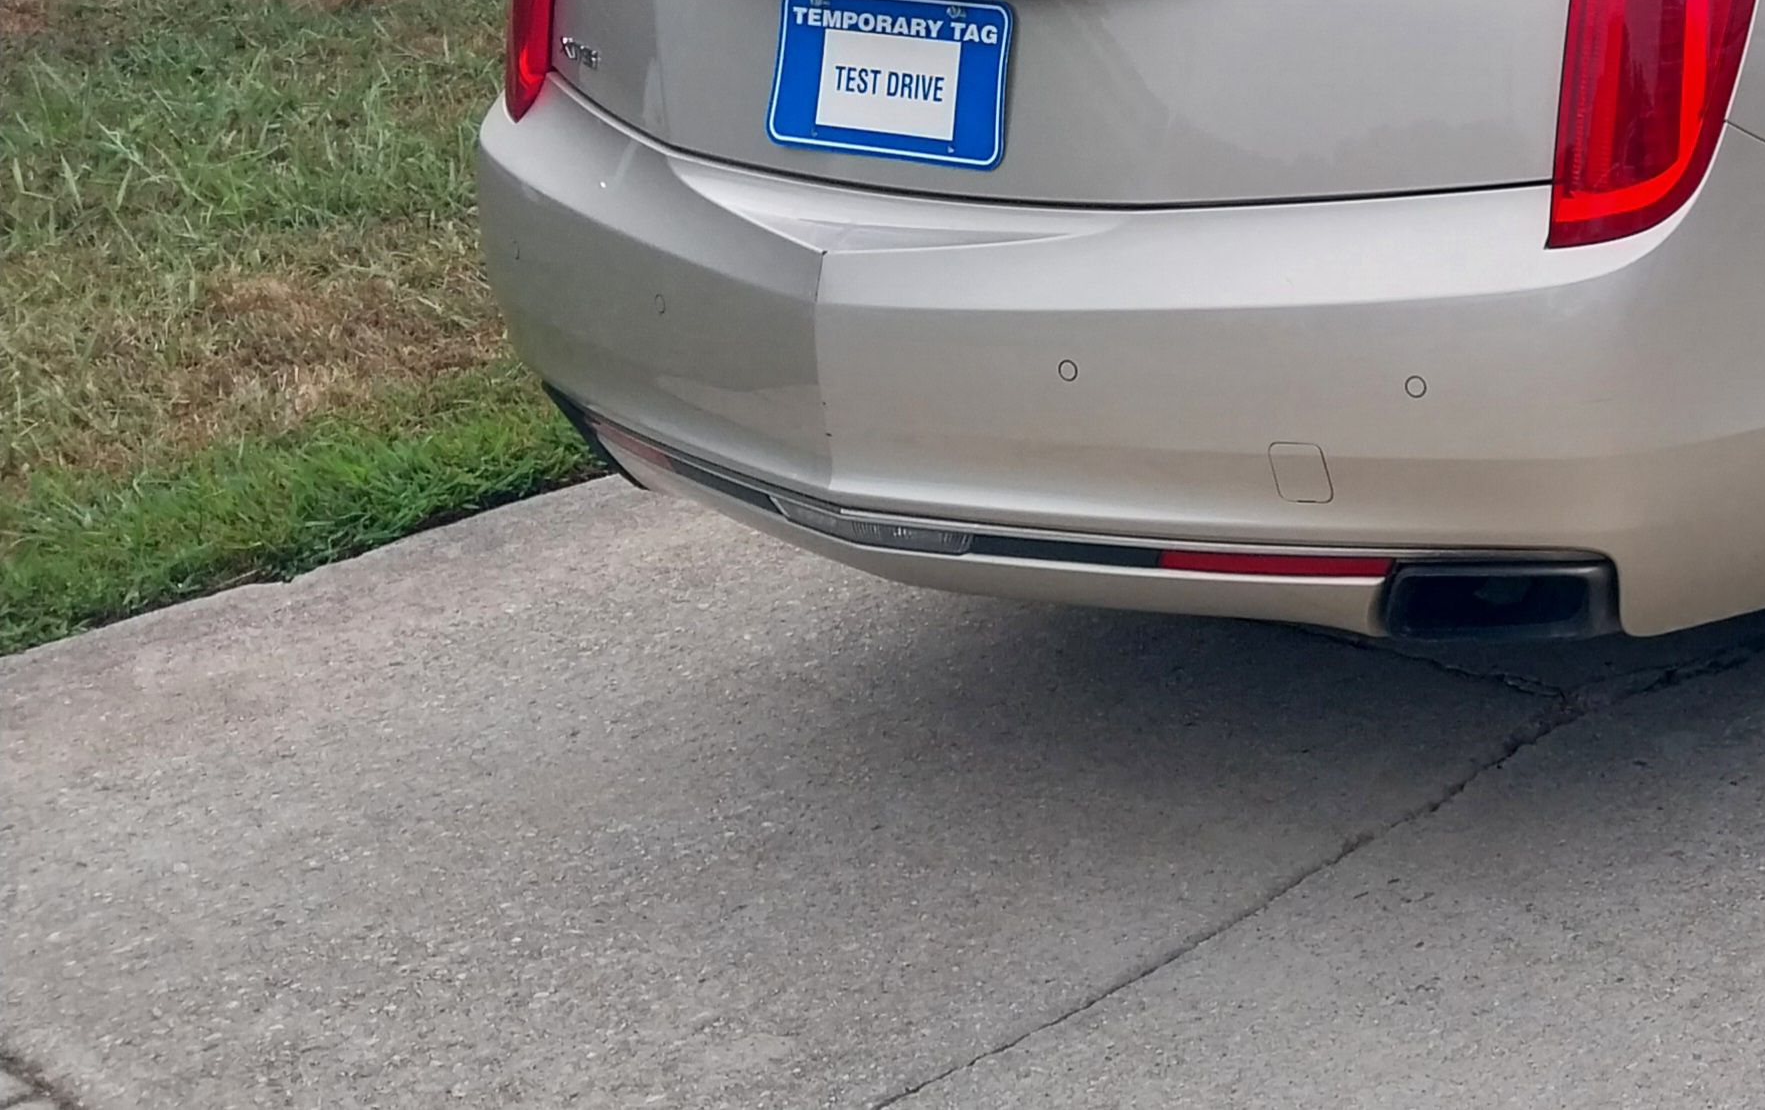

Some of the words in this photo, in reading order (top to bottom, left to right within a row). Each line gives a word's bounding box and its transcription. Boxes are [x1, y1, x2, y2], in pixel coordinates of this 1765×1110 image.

[792, 6, 944, 38] TEMPORARY
[950, 21, 999, 45] TAG
[835, 65, 882, 95] TEST
[886, 71, 945, 102] DRIVE
